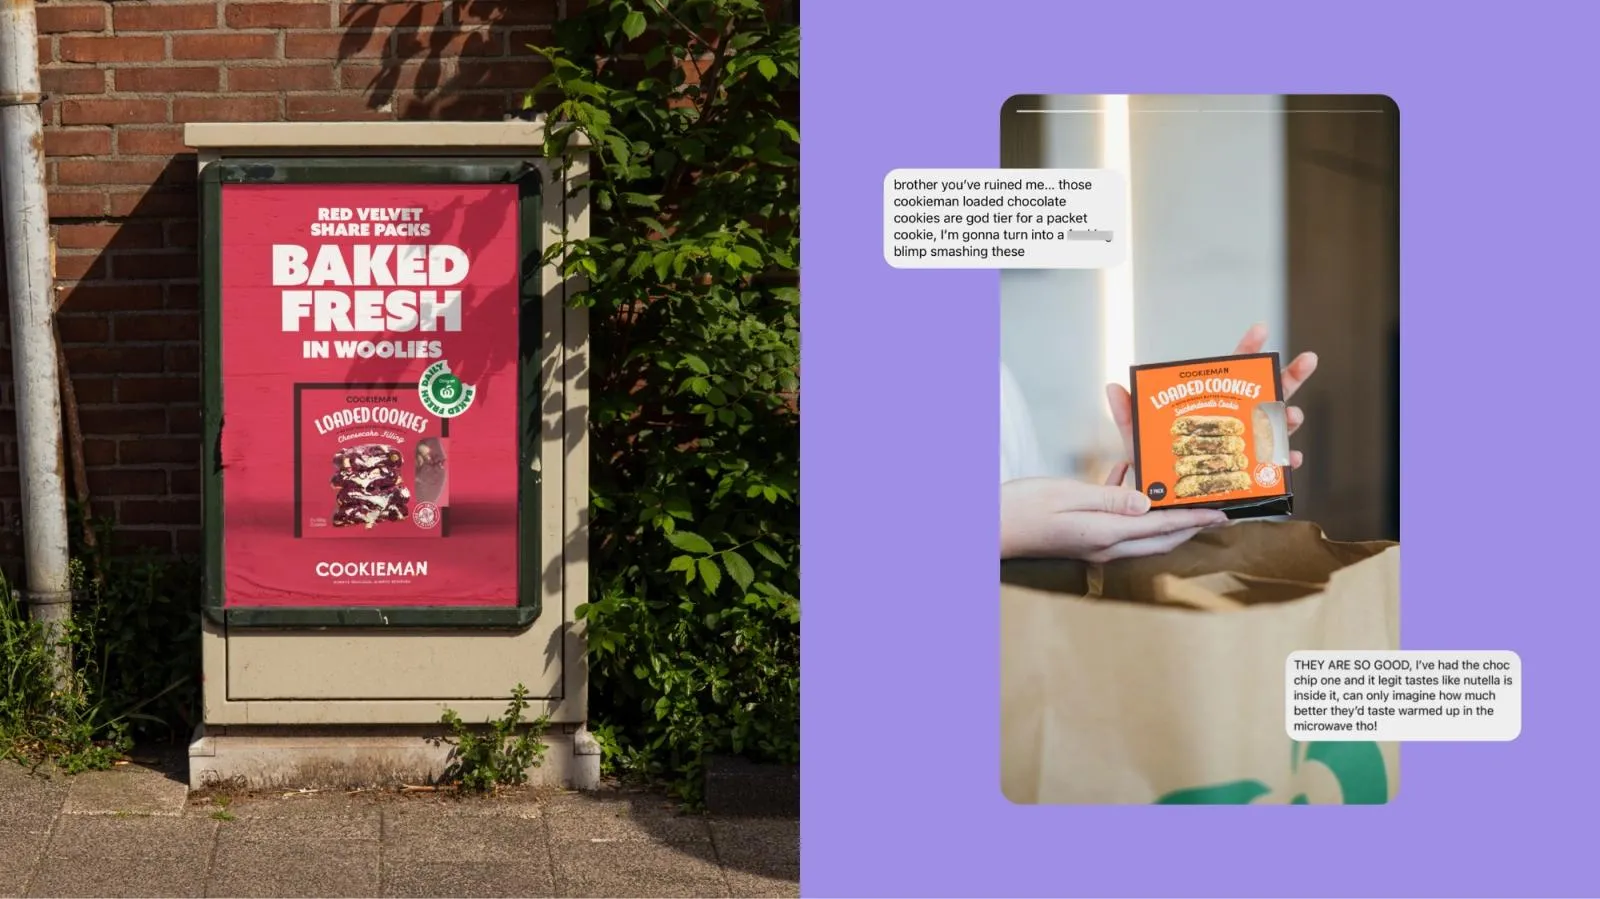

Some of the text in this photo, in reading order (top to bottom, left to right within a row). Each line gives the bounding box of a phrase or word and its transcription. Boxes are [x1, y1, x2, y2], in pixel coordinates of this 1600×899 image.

[318, 207, 423, 221] RED VELVET
[310, 223, 431, 237] SHARE PACKS
[272, 244, 470, 286] BAKED
[281, 290, 463, 332] FRESH
[303, 341, 443, 359] IN WOOLIES
[1179, 367, 1229, 379] COOKIEMAN
[421, 362, 474, 415] BAKED FRESH DAILY
[1149, 379, 1204, 410] LOADED
[1205, 377, 1262, 399] COOKIES
[346, 396, 398, 404] COOKIEMAN
[314, 406, 429, 435] LOADED COOKIES
[337, 430, 379, 444] Cheesecake
[315, 560, 428, 577] COOKIEMAN
